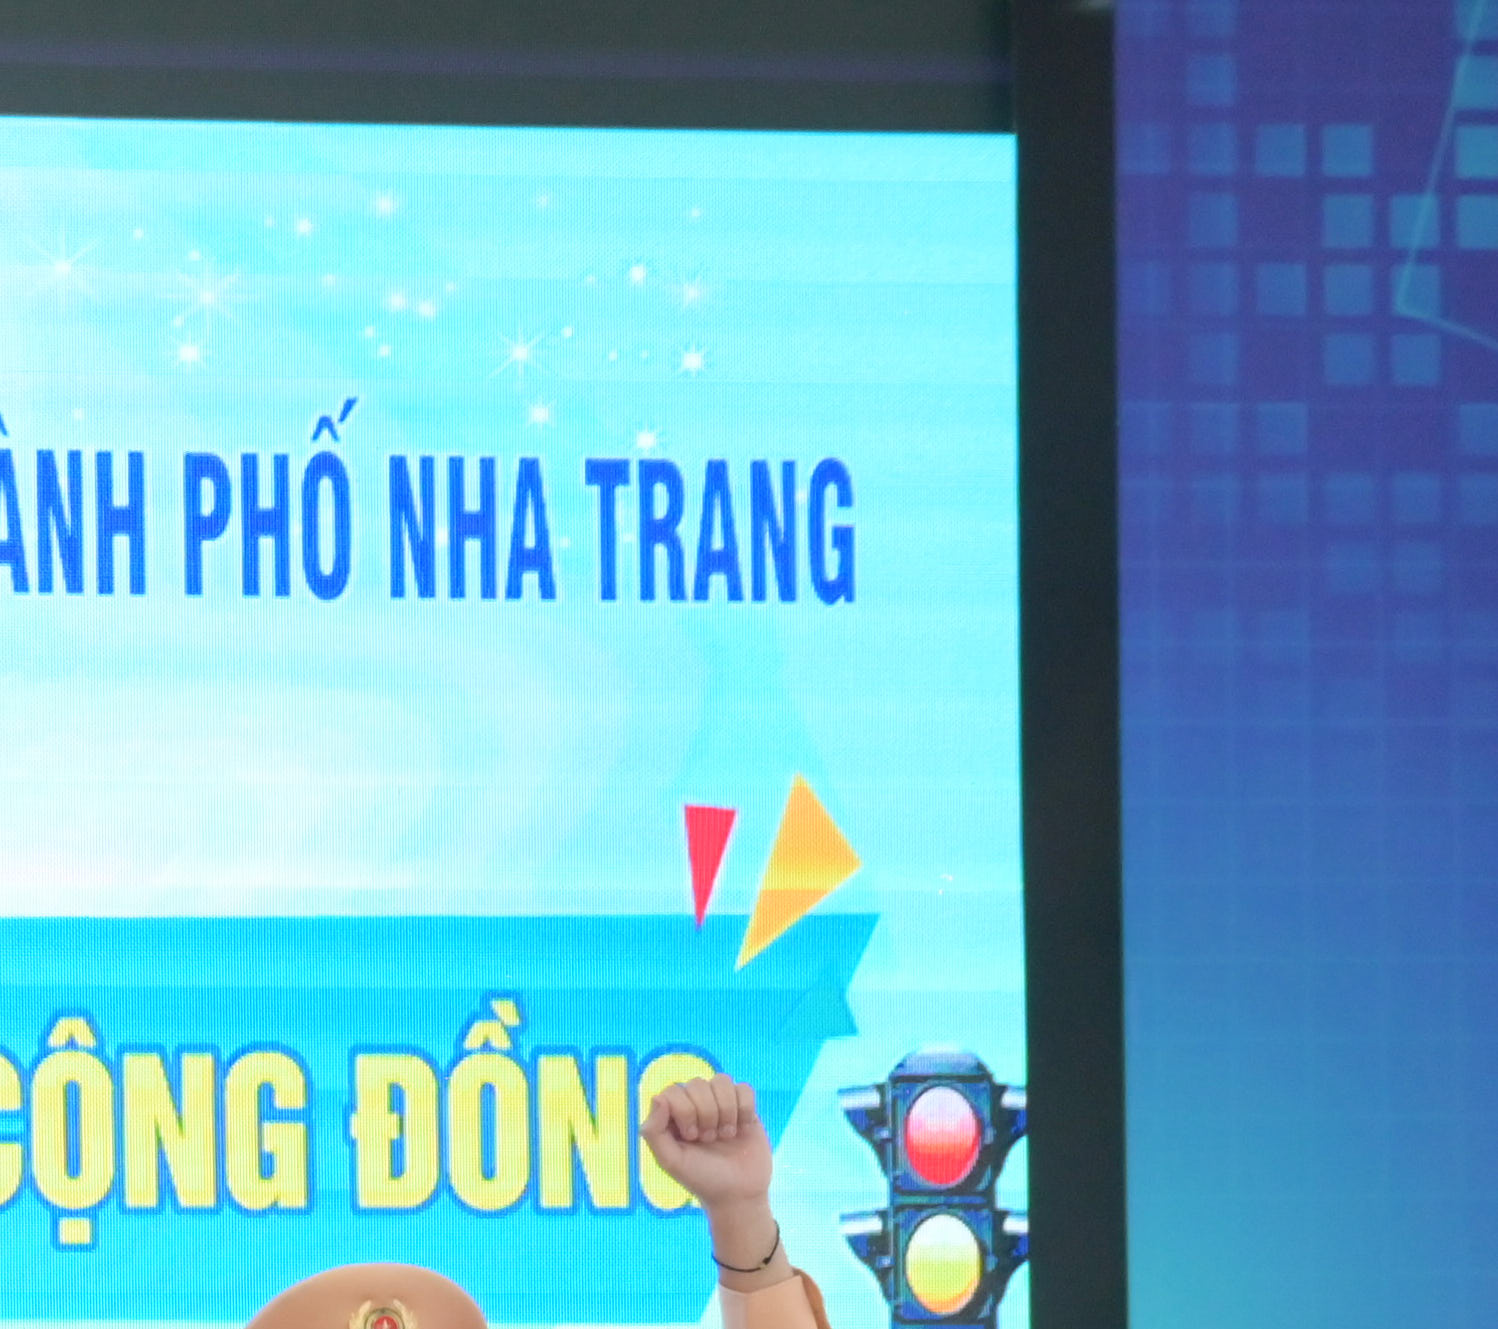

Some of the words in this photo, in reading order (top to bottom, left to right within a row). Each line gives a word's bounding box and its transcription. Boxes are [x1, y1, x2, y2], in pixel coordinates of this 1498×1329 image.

[181, 394, 360, 604] PHỐ
[387, 453, 559, 605] NHA
[582, 455, 860, 609] TRANG
